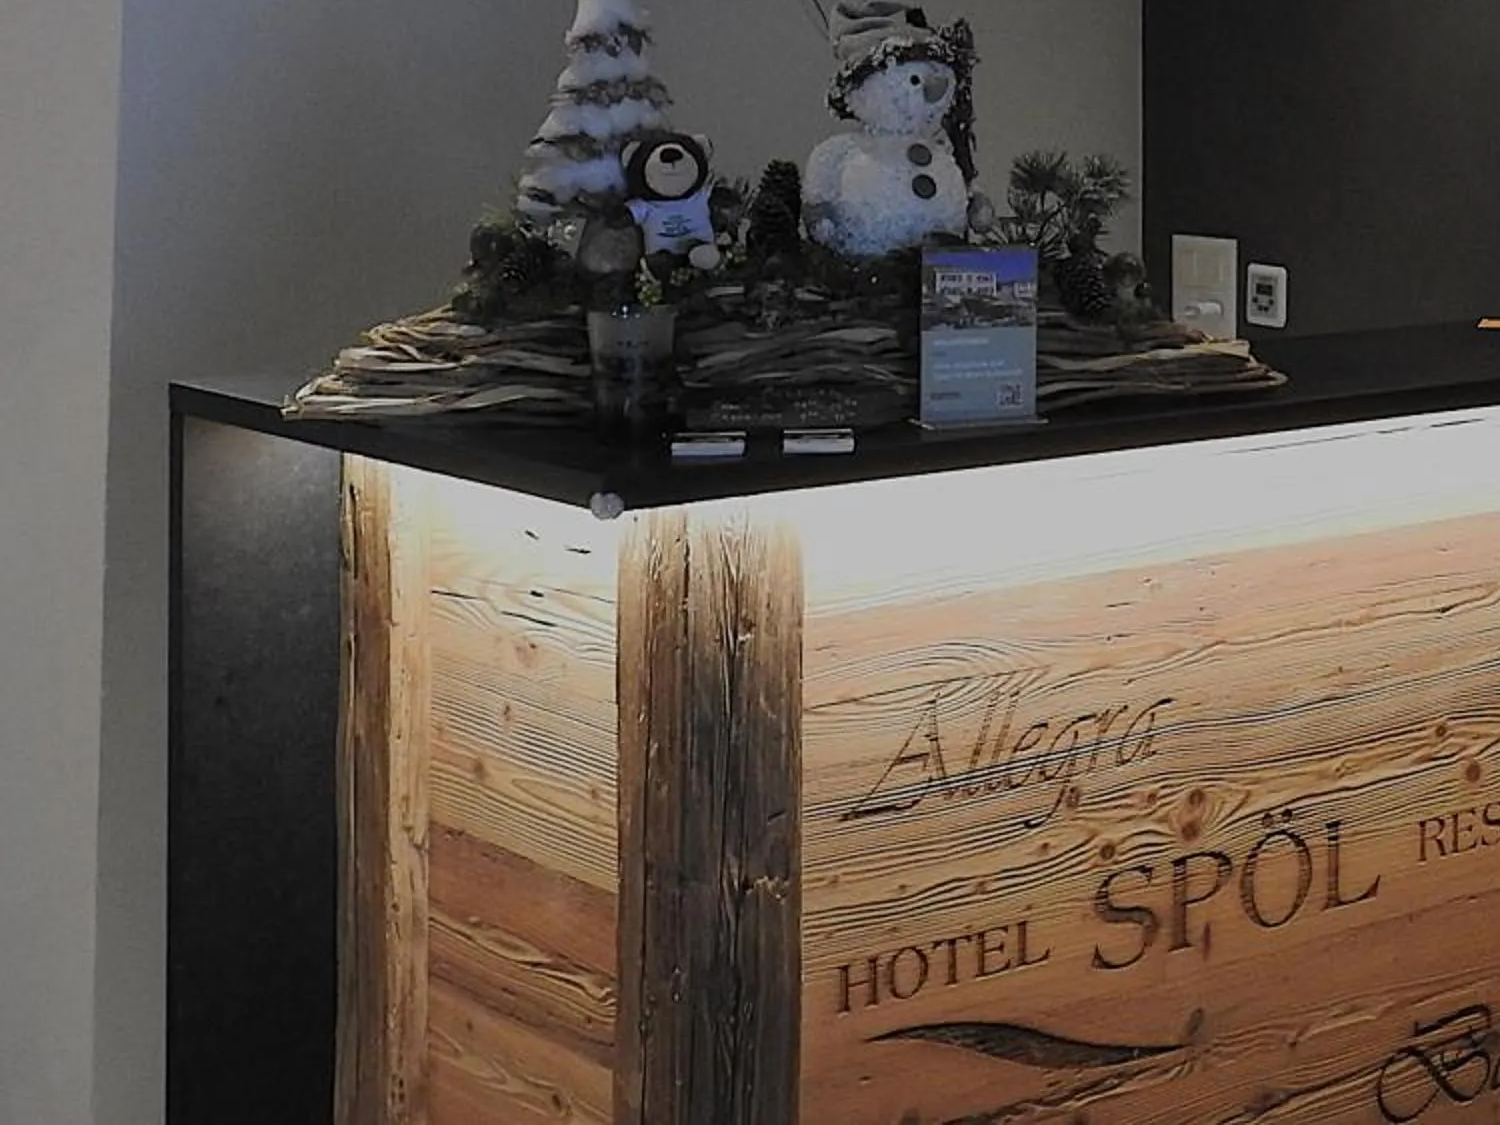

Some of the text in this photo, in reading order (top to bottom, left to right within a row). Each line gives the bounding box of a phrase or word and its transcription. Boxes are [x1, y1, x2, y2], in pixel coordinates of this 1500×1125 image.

[838, 692, 1176, 829] Allegra
[836, 920, 1055, 1013] HOTEL
[1092, 809, 1381, 969] SPÖL
